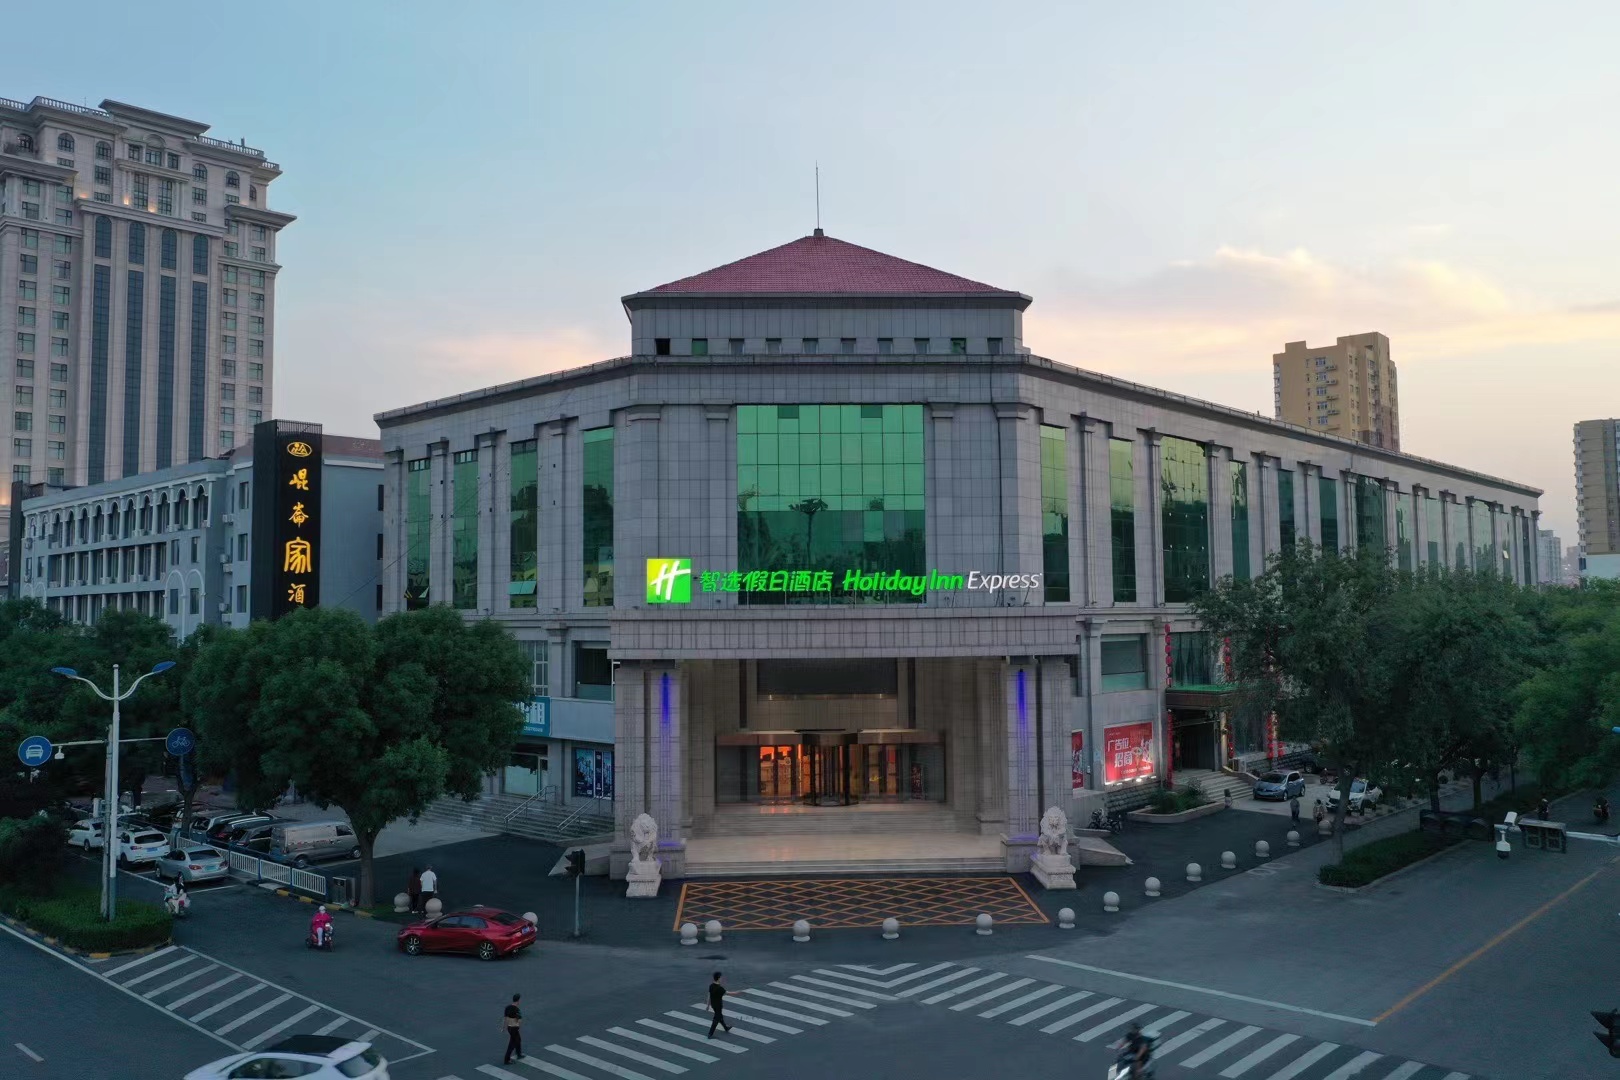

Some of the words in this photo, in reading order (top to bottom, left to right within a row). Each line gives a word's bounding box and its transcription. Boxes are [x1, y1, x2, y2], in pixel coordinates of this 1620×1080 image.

[700, 570, 834, 593] 智选假日酒店
[842, 569, 926, 595] Holiday
[930, 568, 965, 589] Inn
[969, 571, 1042, 593] Express
[1114, 751, 1133, 768] 招商
